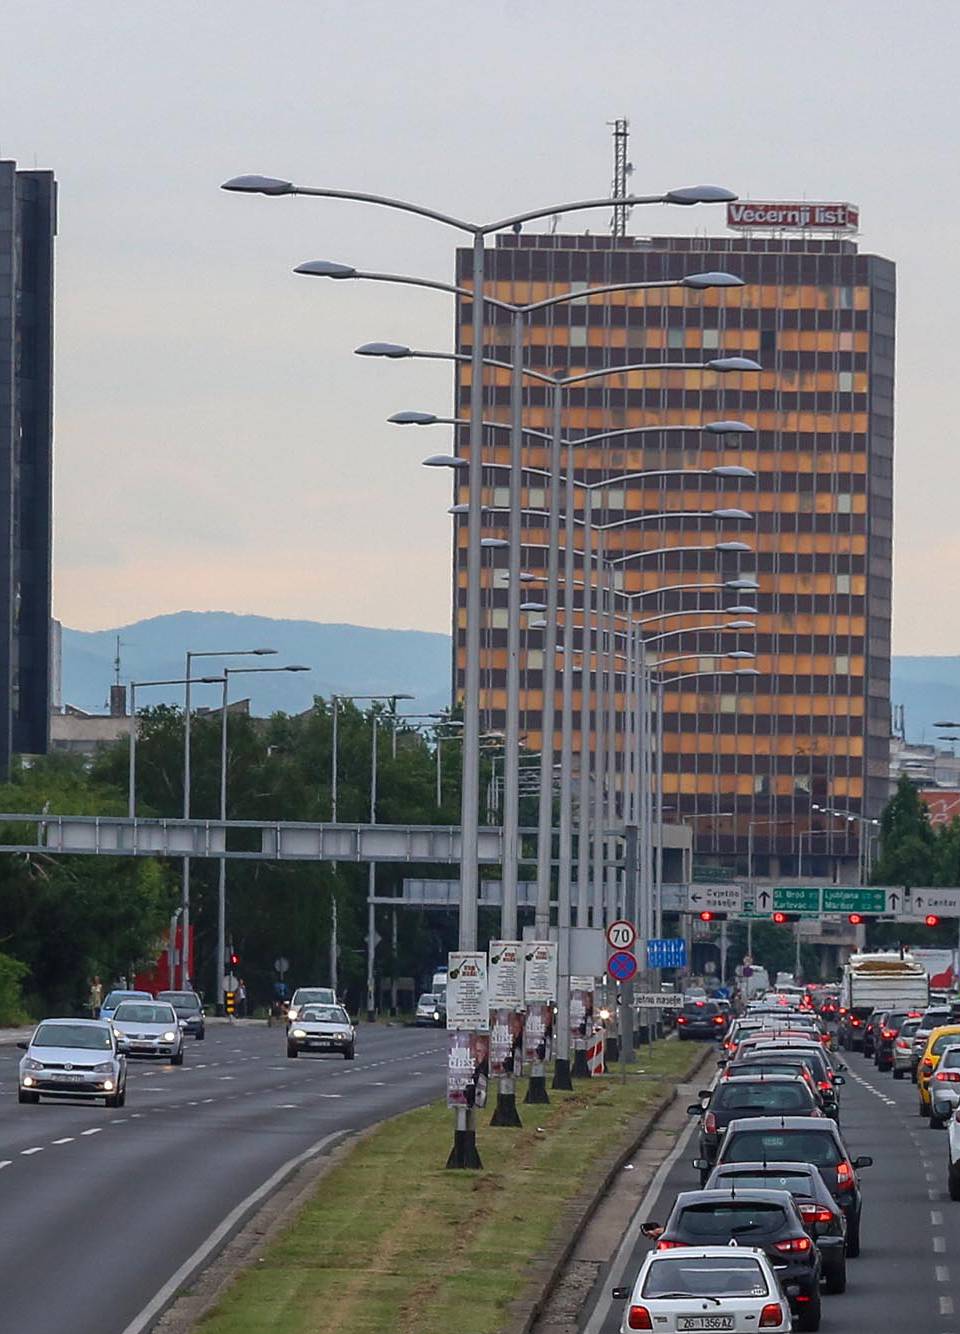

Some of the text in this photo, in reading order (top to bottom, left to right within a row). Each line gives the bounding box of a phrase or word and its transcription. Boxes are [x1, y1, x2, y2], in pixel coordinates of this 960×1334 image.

[729, 206, 845, 225] Večernji list
[613, 929, 630, 943] 70
